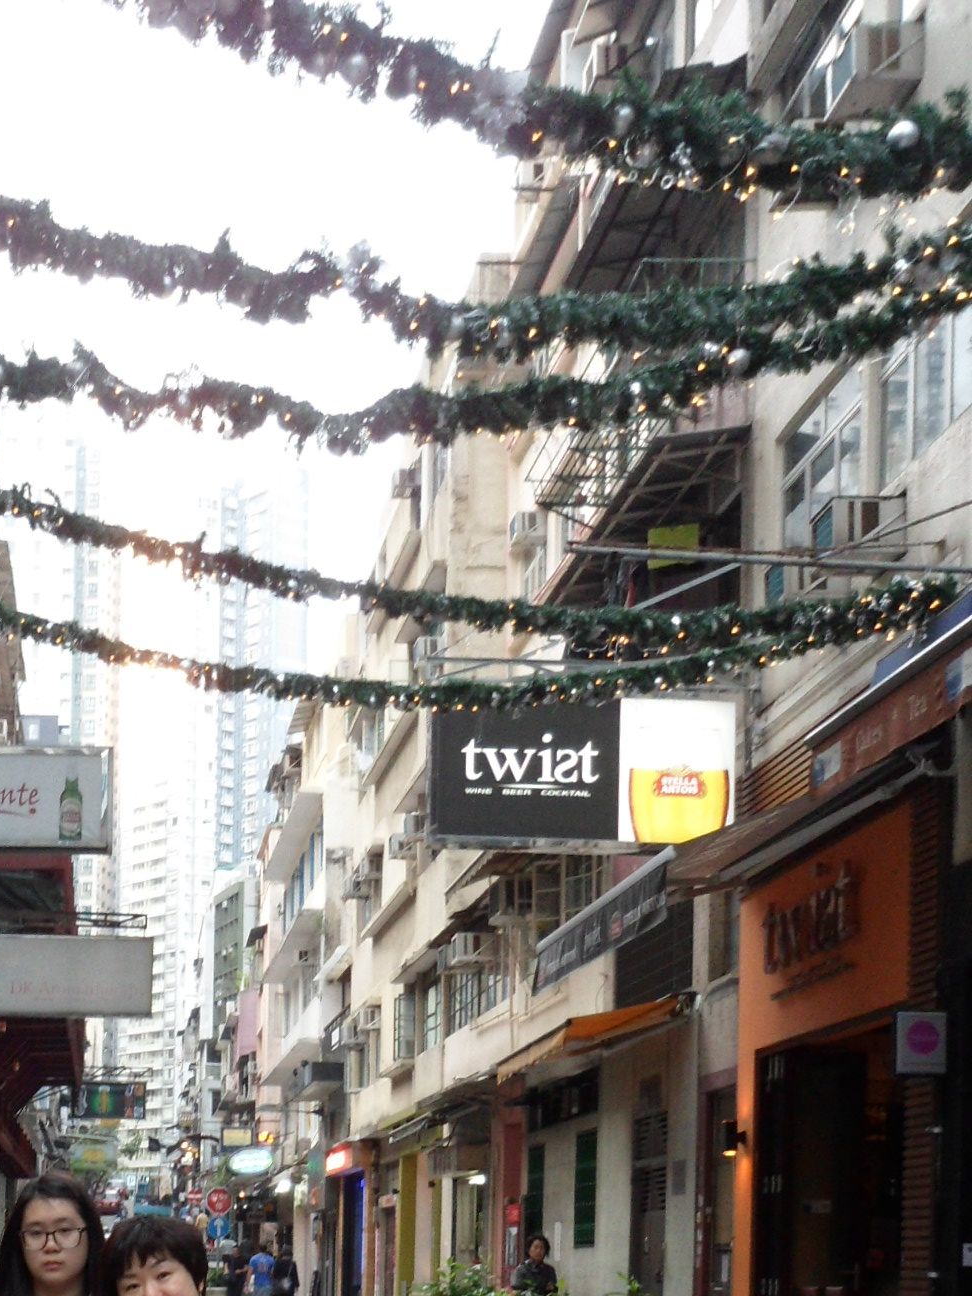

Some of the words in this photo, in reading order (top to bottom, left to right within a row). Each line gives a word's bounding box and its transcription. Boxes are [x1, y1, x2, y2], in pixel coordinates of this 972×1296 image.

[461, 732, 600, 784] twist
[660, 775, 698, 785] STELLA
[464, 787, 493, 796] WINE
[501, 788, 532, 797] BEER
[539, 789, 592, 798] COCKTAIL
[660, 785, 699, 796] ARTOIS
